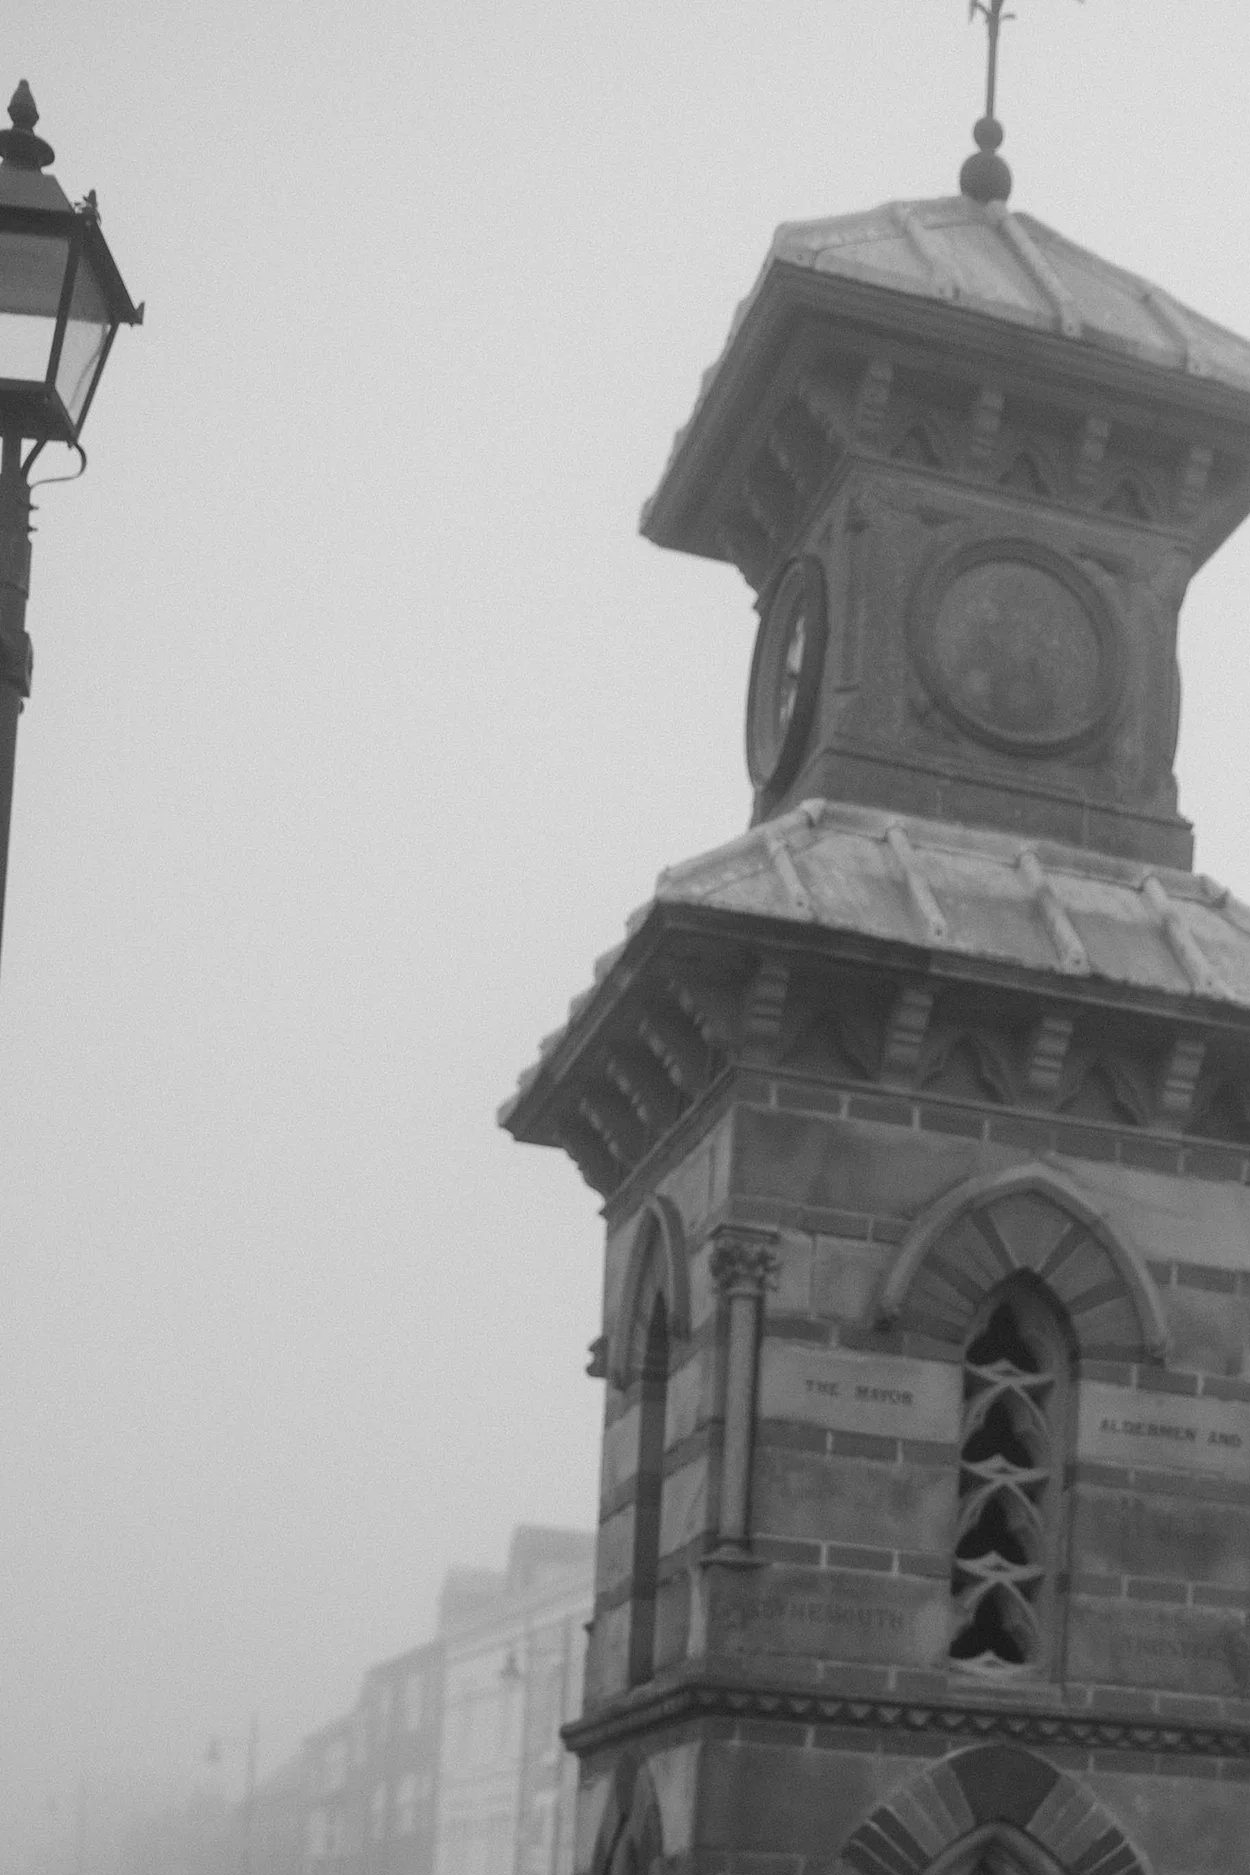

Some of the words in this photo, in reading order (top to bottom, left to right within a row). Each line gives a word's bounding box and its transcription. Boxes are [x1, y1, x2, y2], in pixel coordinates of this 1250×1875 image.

[805, 1379, 839, 1397] THE
[855, 1385, 914, 1405] MAYOR
[1099, 1417, 1198, 1442] ALDERMEN
[1207, 1430, 1243, 1448] AND
